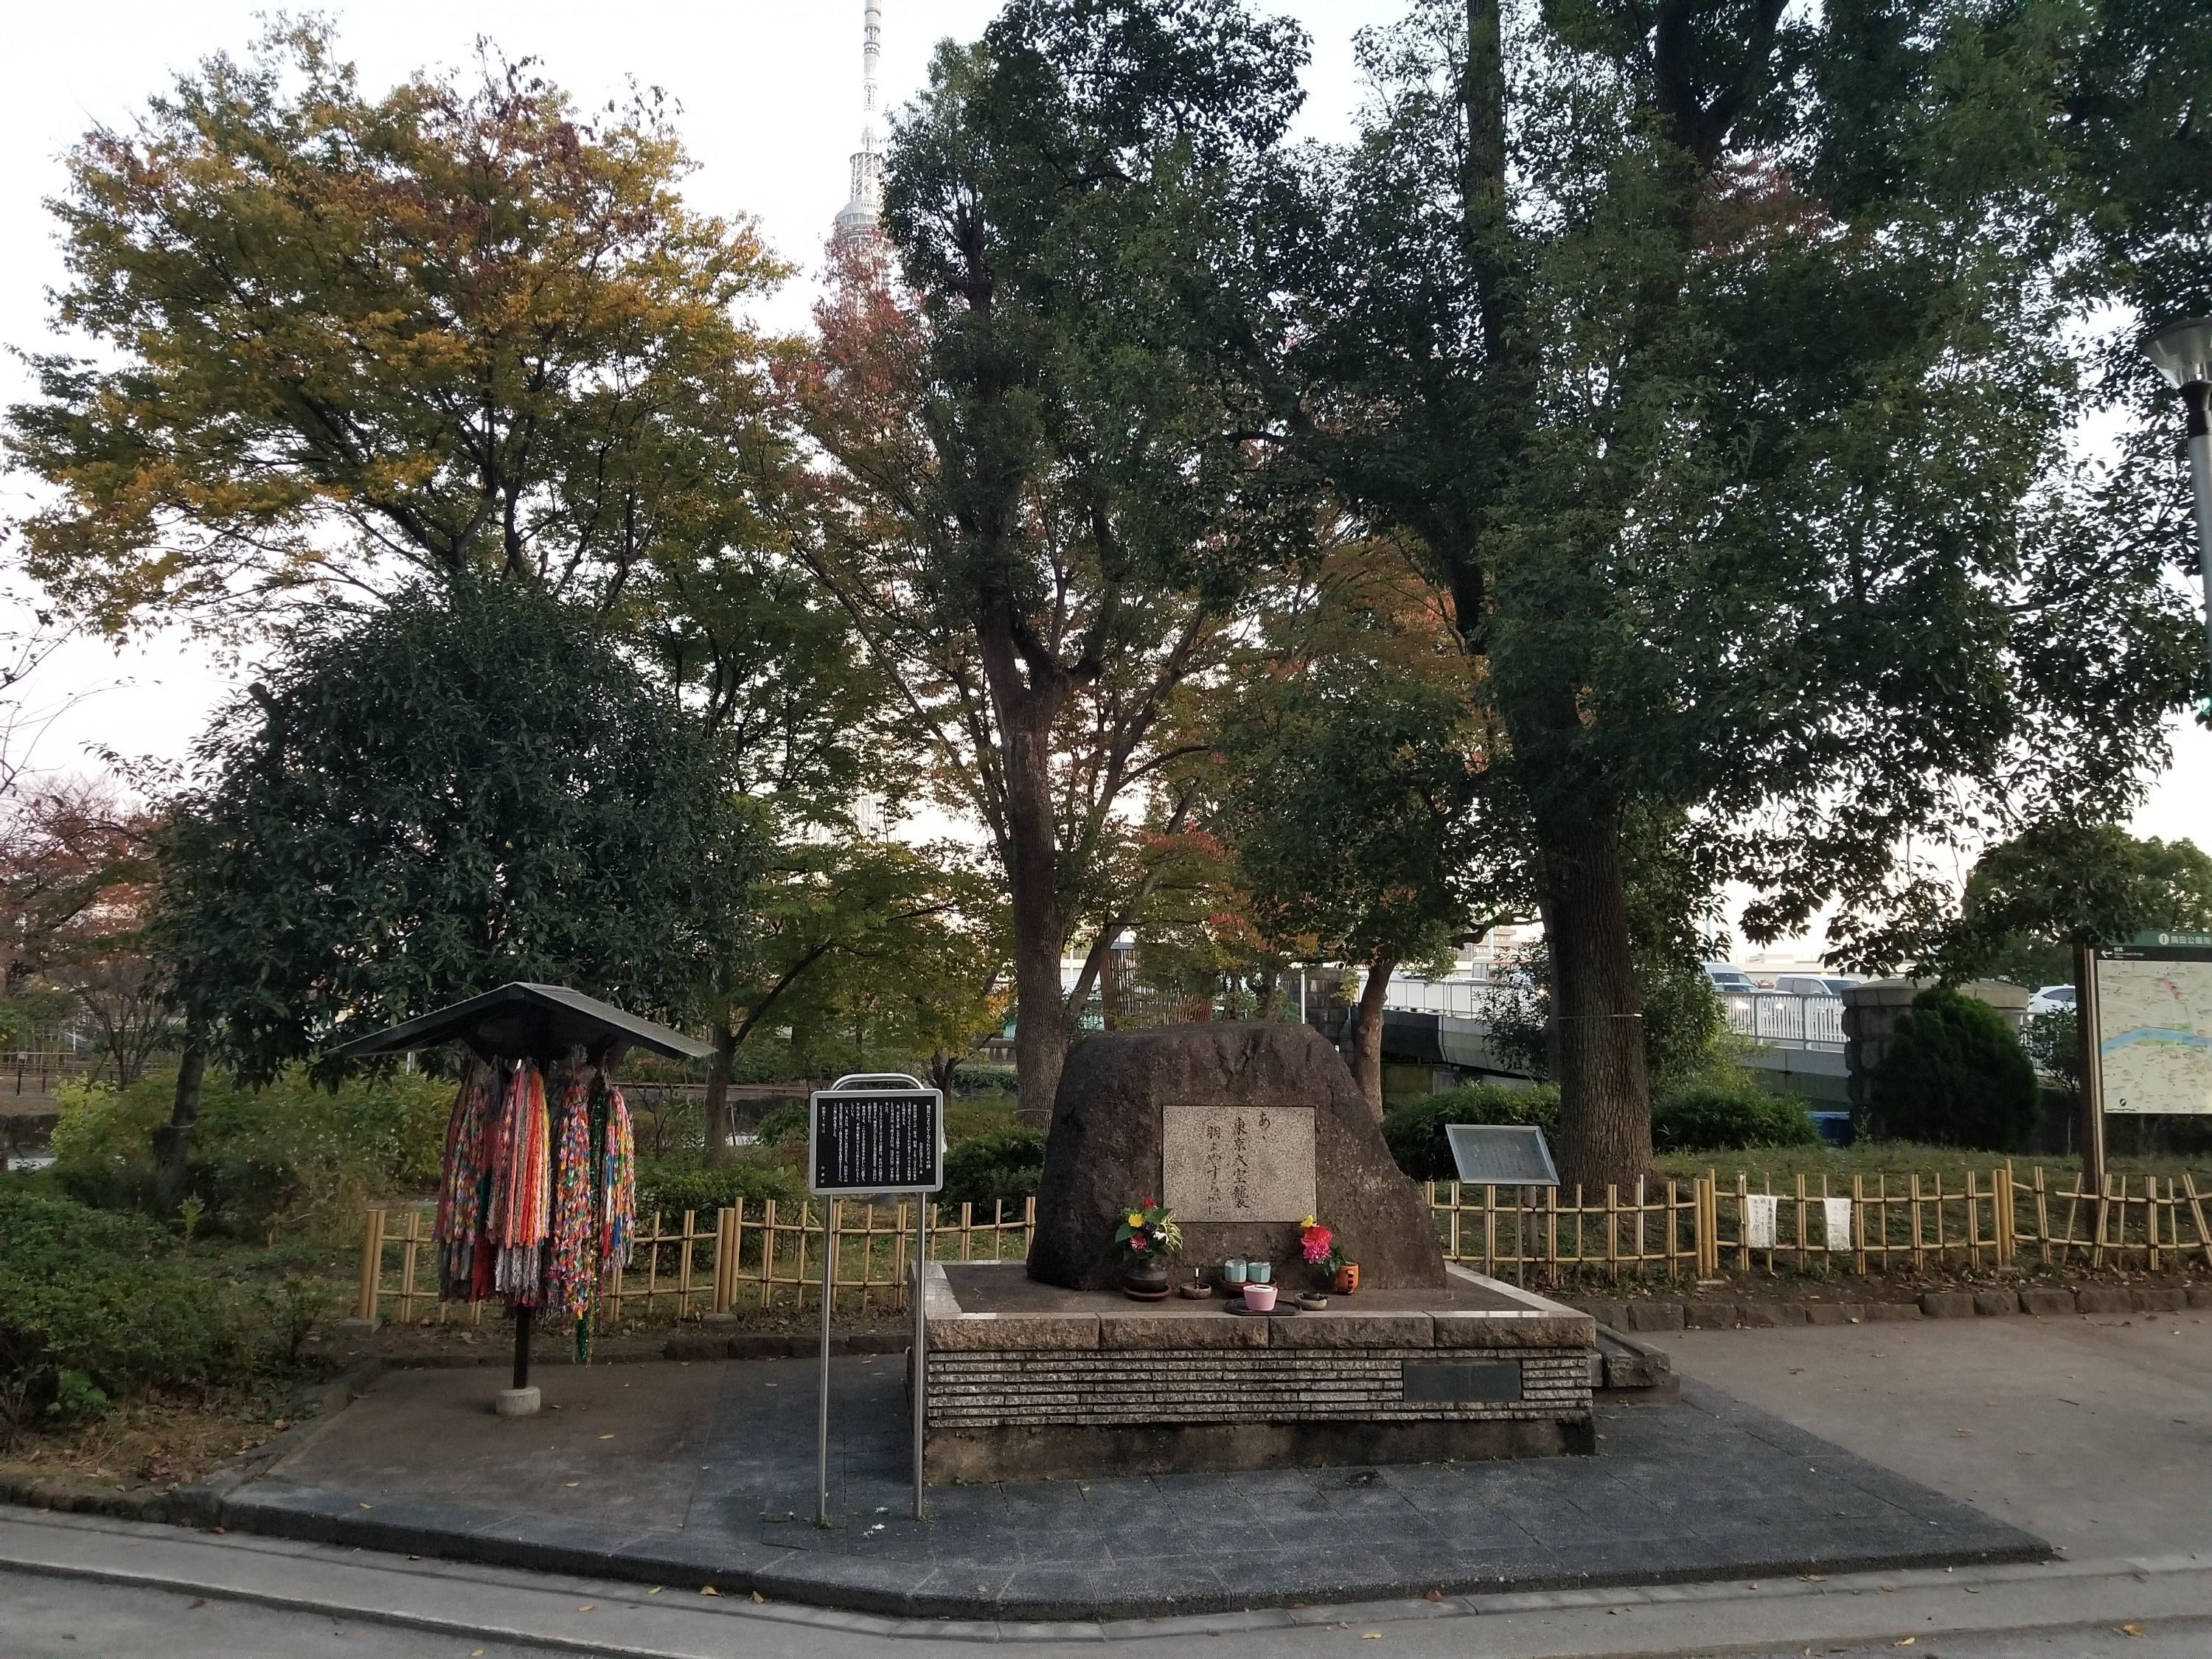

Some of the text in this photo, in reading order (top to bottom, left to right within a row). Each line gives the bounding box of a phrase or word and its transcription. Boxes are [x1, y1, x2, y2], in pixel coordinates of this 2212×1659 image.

[1231, 1116, 1249, 1208] 東京大空襲
